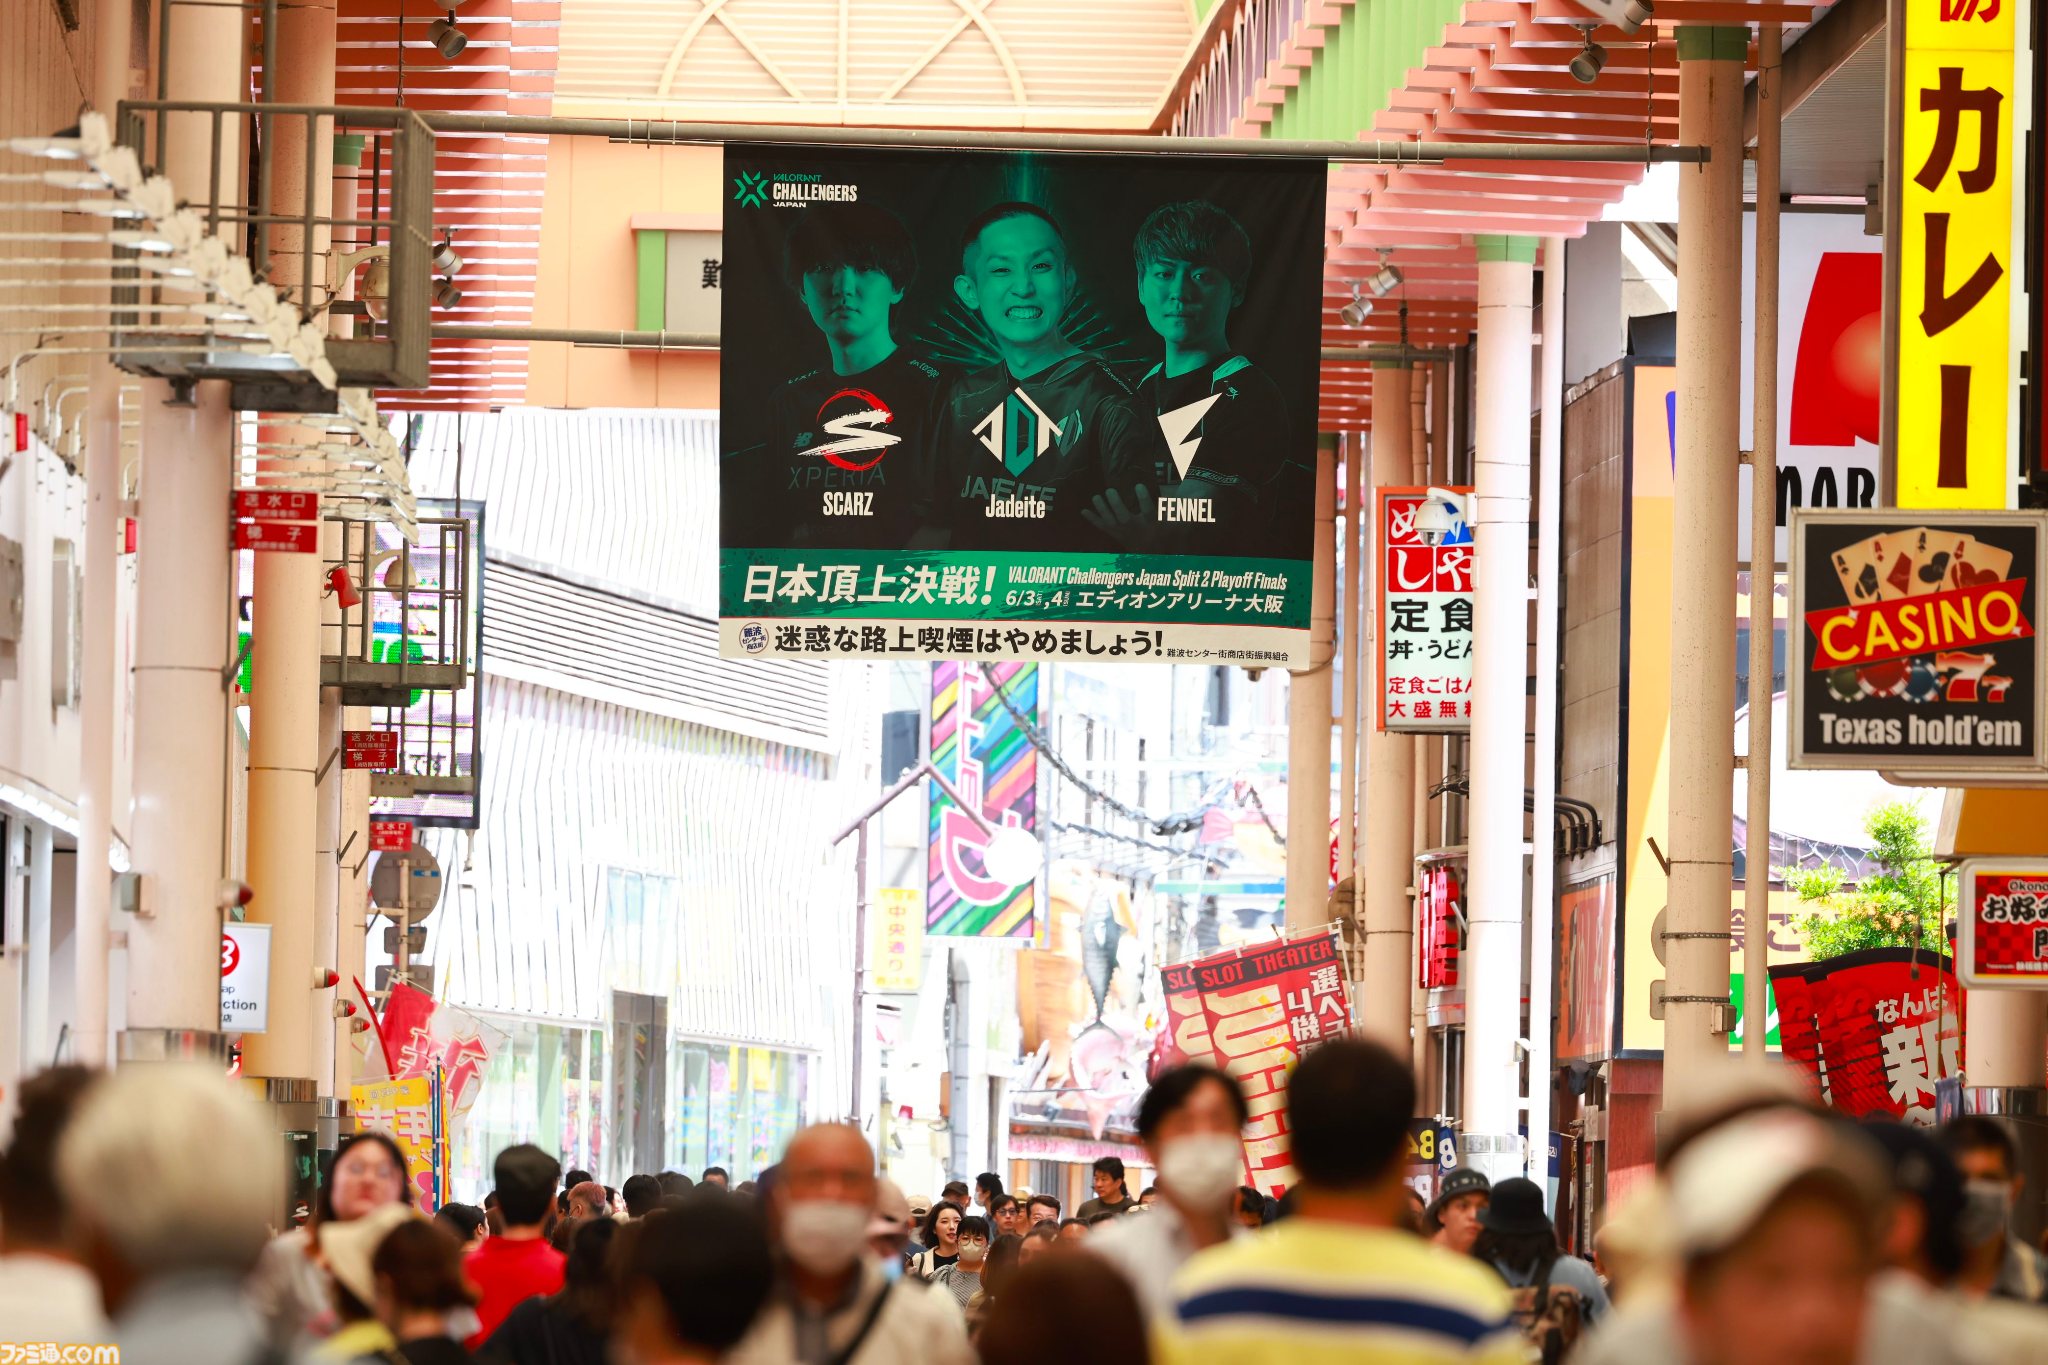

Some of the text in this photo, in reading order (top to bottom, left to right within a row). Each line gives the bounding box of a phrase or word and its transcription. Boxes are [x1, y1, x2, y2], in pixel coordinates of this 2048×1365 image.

[773, 173, 822, 182] VALORANT
[773, 183, 858, 202] CHALLENGERS
[1913, 67, 2004, 489] カレー
[822, 491, 874, 516] SCARZ
[985, 493, 1046, 518] Jadeite
[1157, 497, 1216, 523] FENNEL
[743, 563, 997, 606] 日本頂上決戦!
[1008, 566, 1287, 592] VALORANT Challengers Japan Split 2 Playoff Finals
[1075, 591, 1284, 614] エディオンアリーナ大阪
[1390, 598, 1472, 632] 定食
[1821, 590, 2019, 662] CASINO
[774, 625, 1163, 656] 迷惑な路上喫煙はやめましょう!
[1167, 648, 1289, 662] 難波センター街商店街振興組合
[351, 732, 390, 742] 送水口
[1819, 713, 2022, 747] Texas hold'em
[353, 752, 388, 761] 梯子
[1201, 939, 1334, 988] SLOT THEATER
[1876, 983, 1948, 1024] なんば
